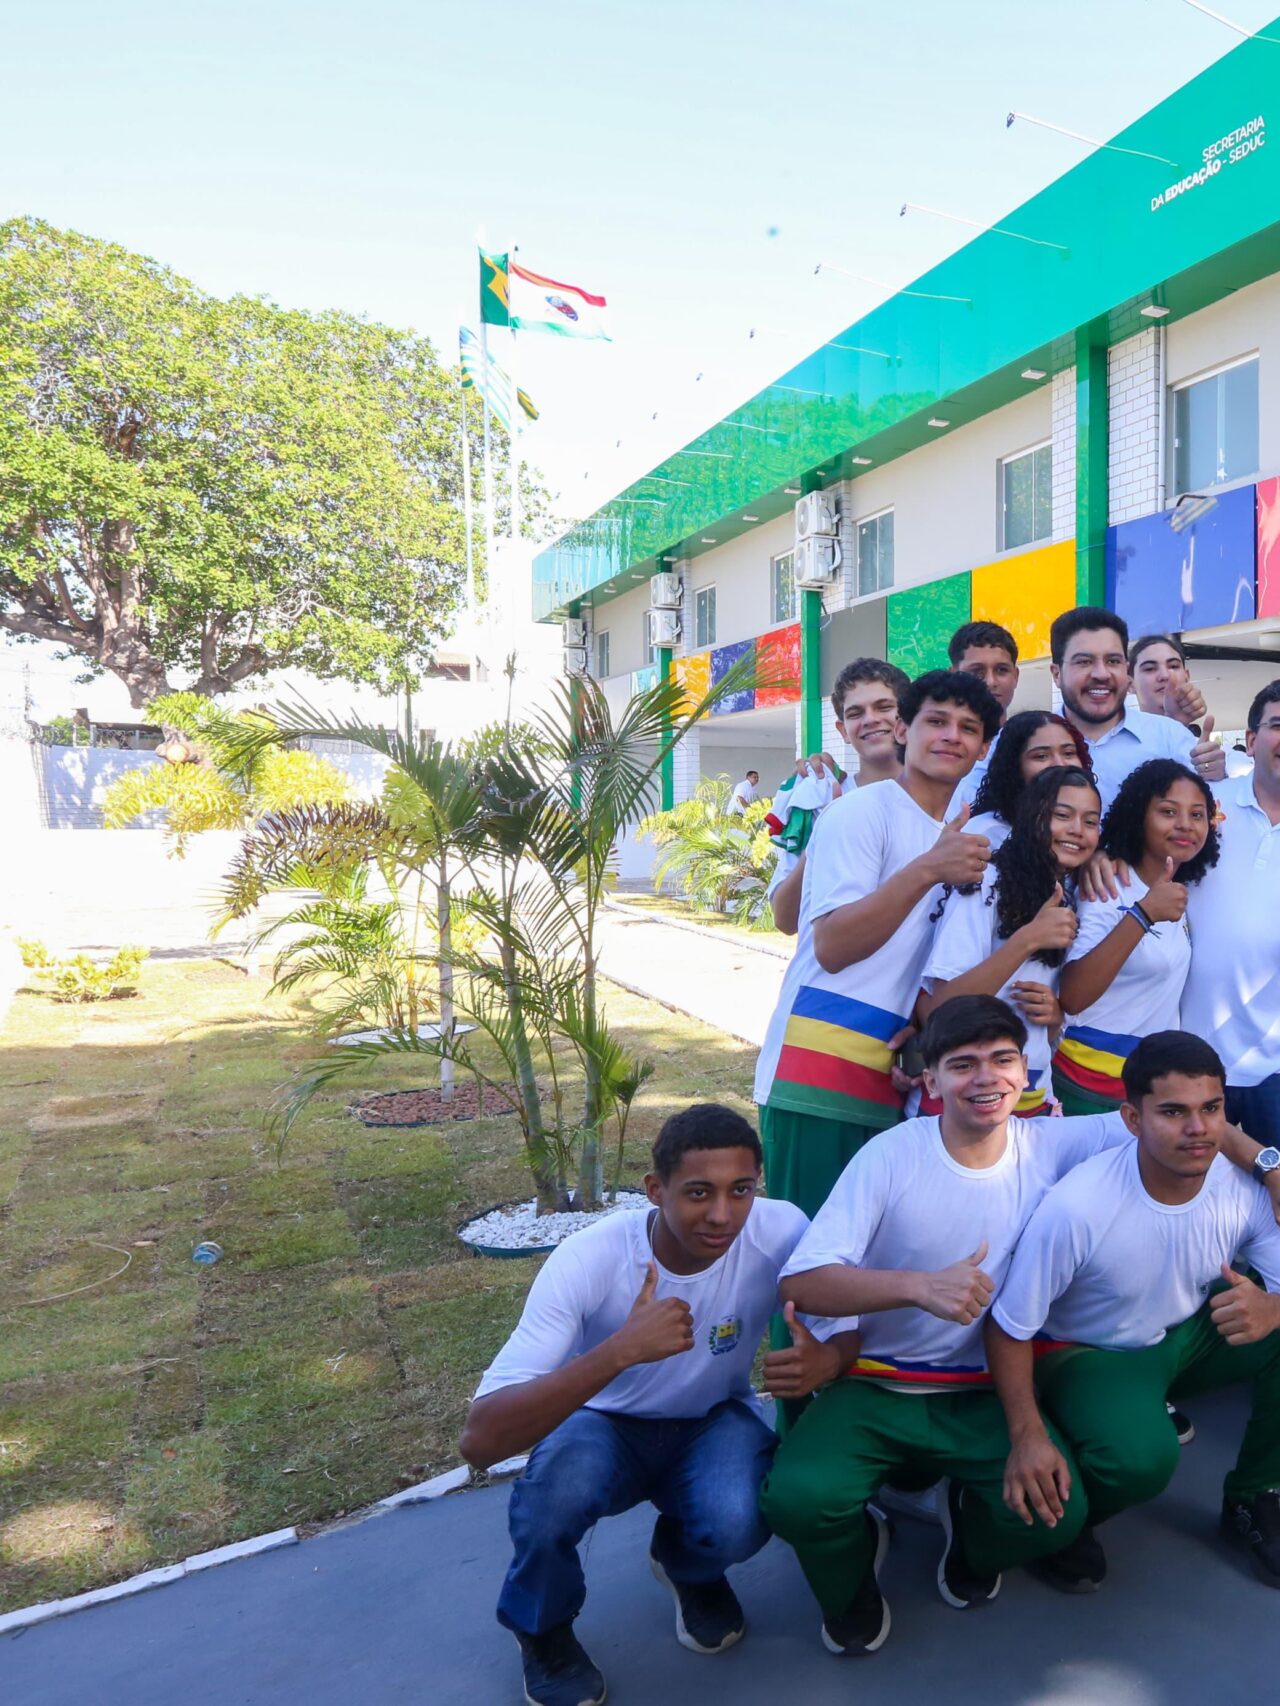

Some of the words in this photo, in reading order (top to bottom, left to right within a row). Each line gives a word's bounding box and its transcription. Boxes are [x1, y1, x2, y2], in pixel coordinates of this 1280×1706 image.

[1202, 115, 1265, 162] SECRETARIA
[1151, 193, 1164, 212] DA
[1165, 159, 1221, 203] EDUCAÇÃO
[1229, 131, 1265, 164] SEDUC
